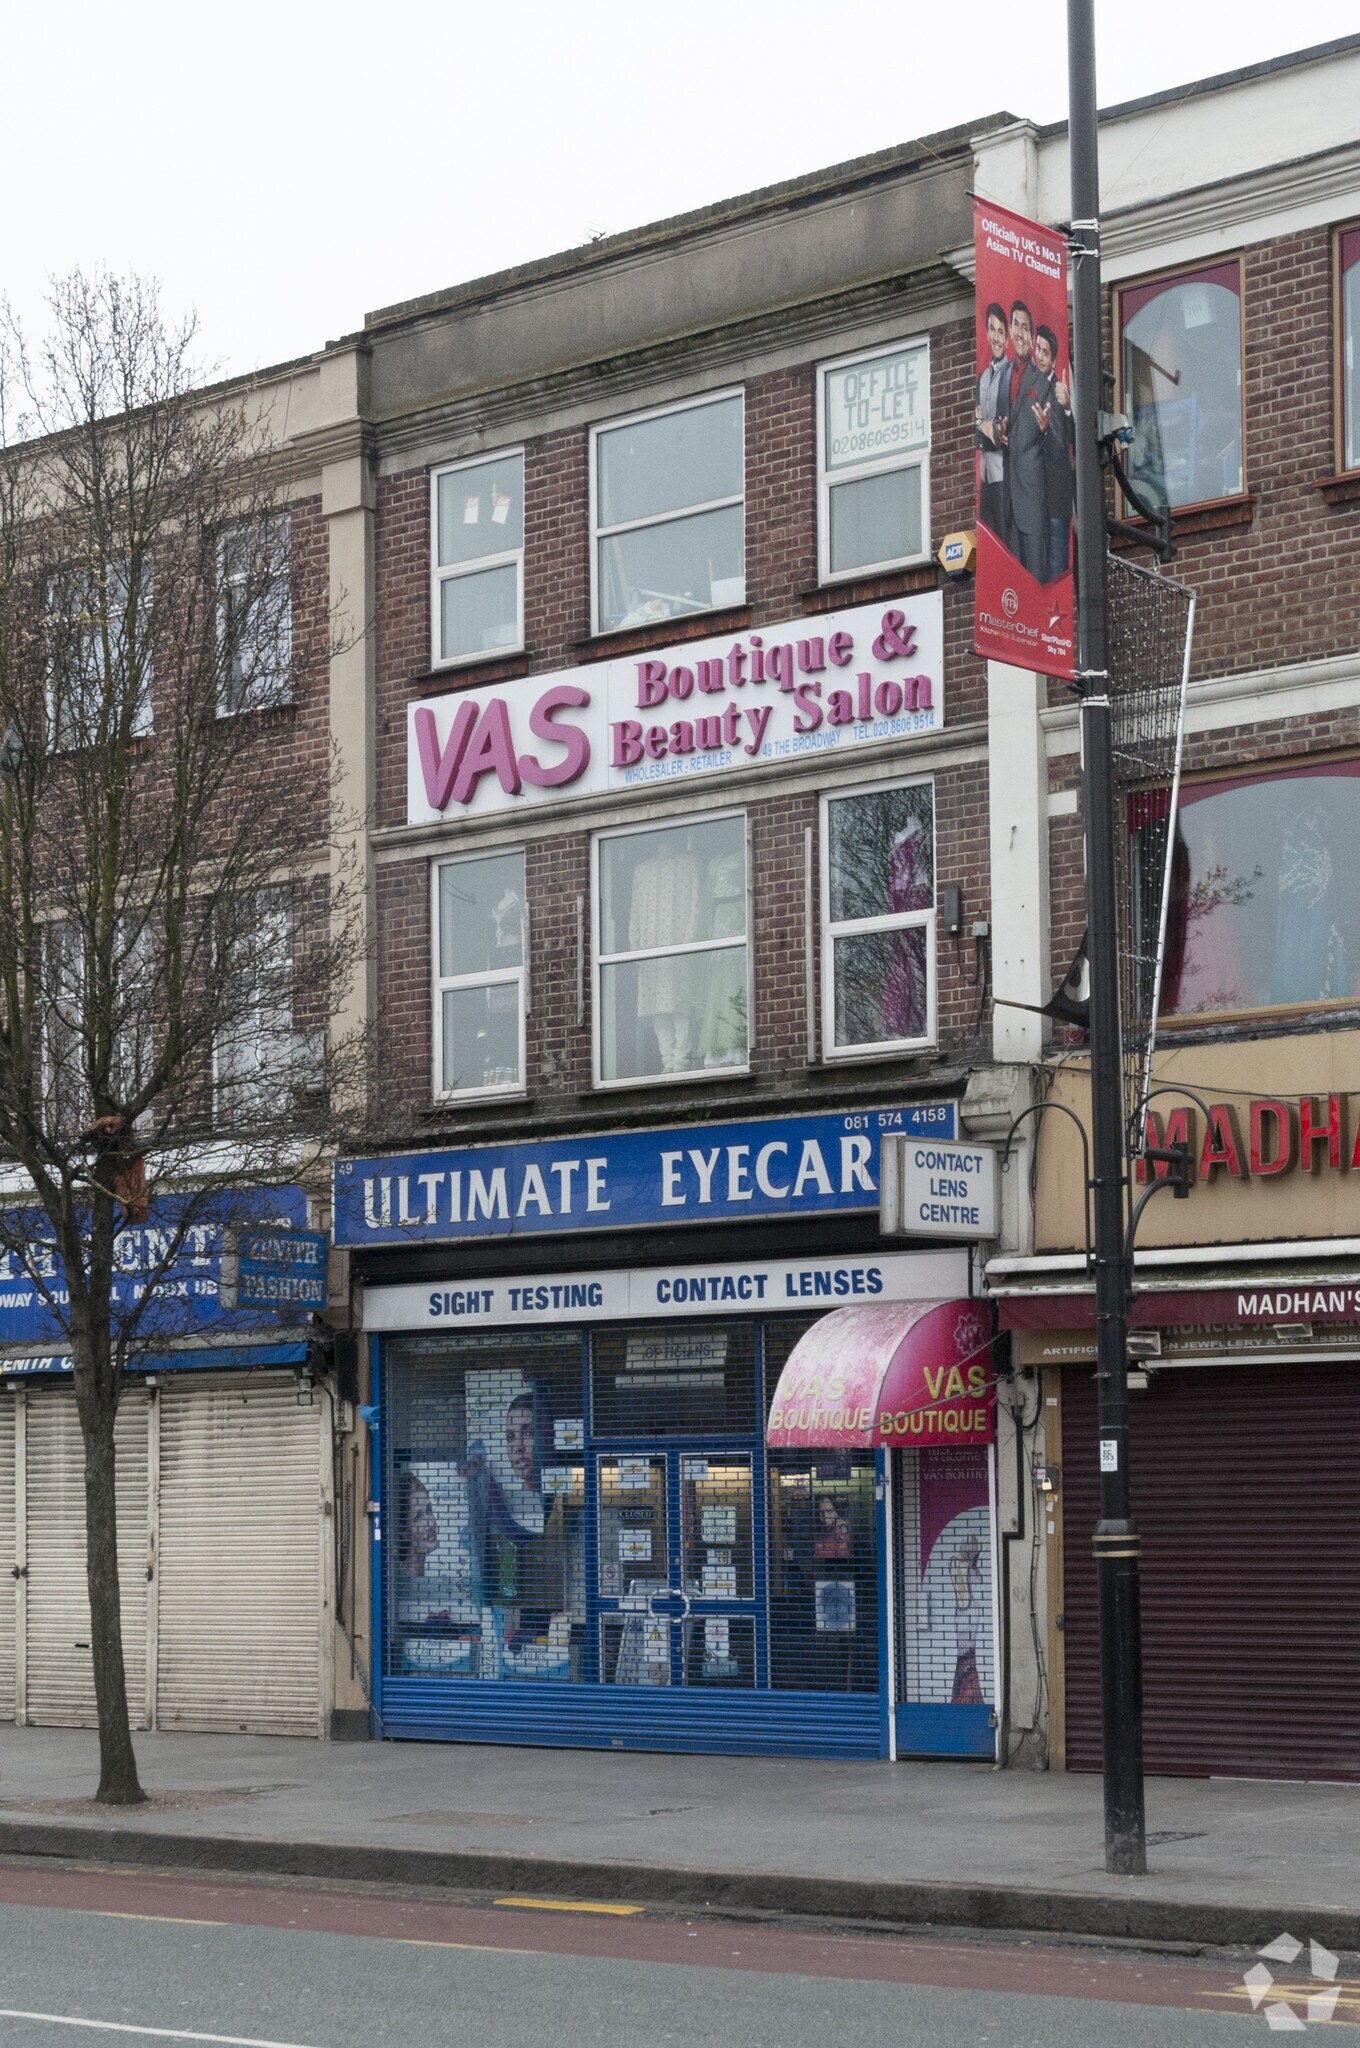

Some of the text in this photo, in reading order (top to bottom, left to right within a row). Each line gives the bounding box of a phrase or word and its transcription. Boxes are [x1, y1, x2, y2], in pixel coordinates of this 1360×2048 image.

[981, 218, 1062, 265] Officially UK's No.1
[986, 237, 1060, 279] Asian TV Channel
[844, 356, 918, 403] OFFICE
[844, 385, 918, 431] TO-LET
[832, 418, 925, 455] 02086069514
[945, 544, 963, 560] ADT
[634, 609, 918, 709] Boutique &
[609, 672, 934, 768] Beauty Salon
[414, 685, 592, 811] VAS
[625, 761, 683, 783] WHOLESALER
[690, 751, 732, 772] RETAILER
[762, 741, 773, 757] 49
[774, 739, 792, 756] THE
[793, 728, 841, 752] BROADWAY
[891, 717, 912, 735] 8606
[914, 713, 935, 731] 9514
[844, 1108, 947, 1130] 081 574 4158
[1135, 1092, 1360, 1185] MADH
[915, 1150, 983, 1174] CONTACT
[362, 1131, 907, 1229] ULTIMATE EYECAR
[930, 1178, 968, 1198] LENS
[920, 1203, 980, 1225] CENTRE
[429, 1283, 603, 1316] SIGHT TESTING
[657, 1267, 884, 1303] CONTACT LENSES
[645, 1344, 712, 1360] OPTICIANS
[1280, 1334, 1360, 1345] ACCESSOR
[0, 1357, 53, 1371] ENITH
[782, 1375, 848, 1401] VAS
[923, 1365, 987, 1400] VAS
[771, 1408, 872, 1432] BOUTIQUE
[879, 1409, 987, 1435] BOUTIQUE
[928, 1448, 980, 1462] Welcome
